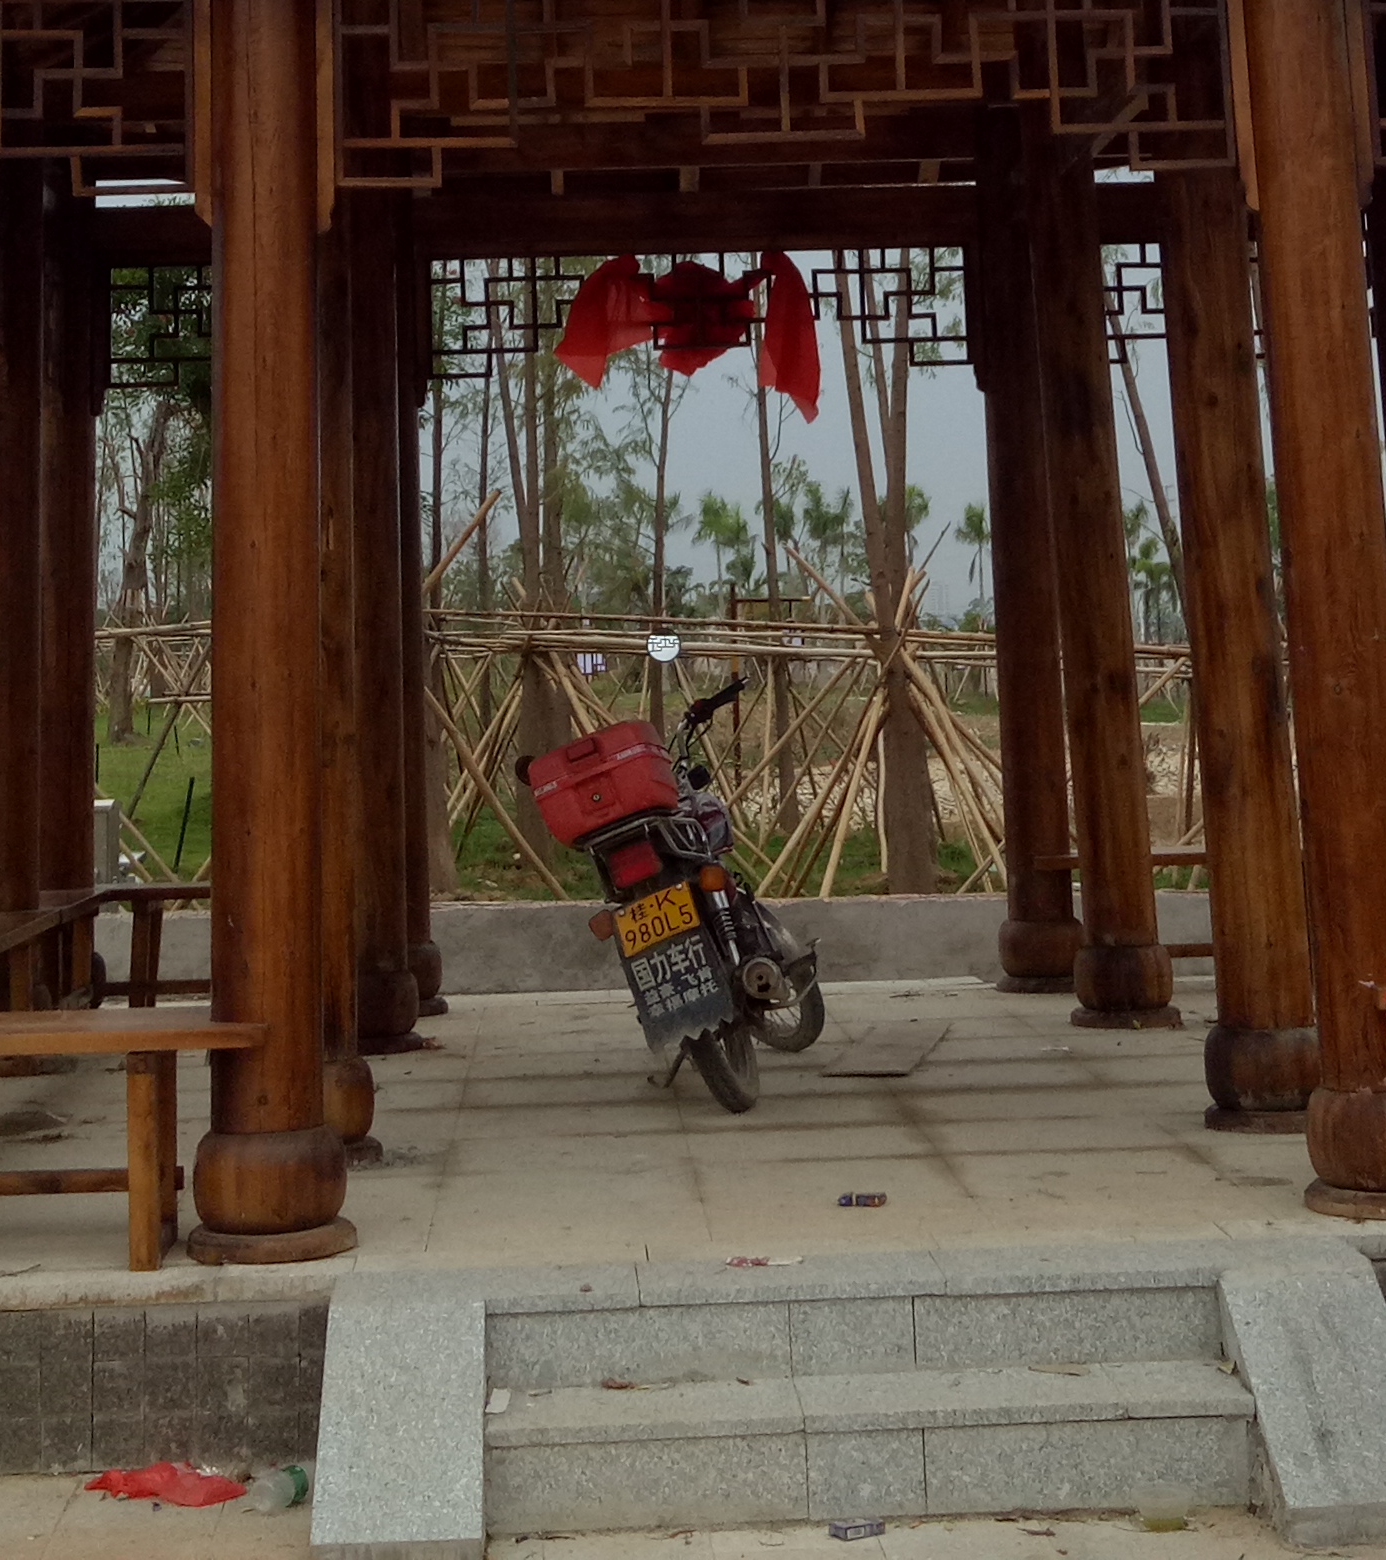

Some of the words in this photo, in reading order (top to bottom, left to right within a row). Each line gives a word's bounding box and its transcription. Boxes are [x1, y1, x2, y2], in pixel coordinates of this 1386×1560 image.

[625, 903, 693, 950] 980L5
[631, 935, 707, 990] 国力车行
